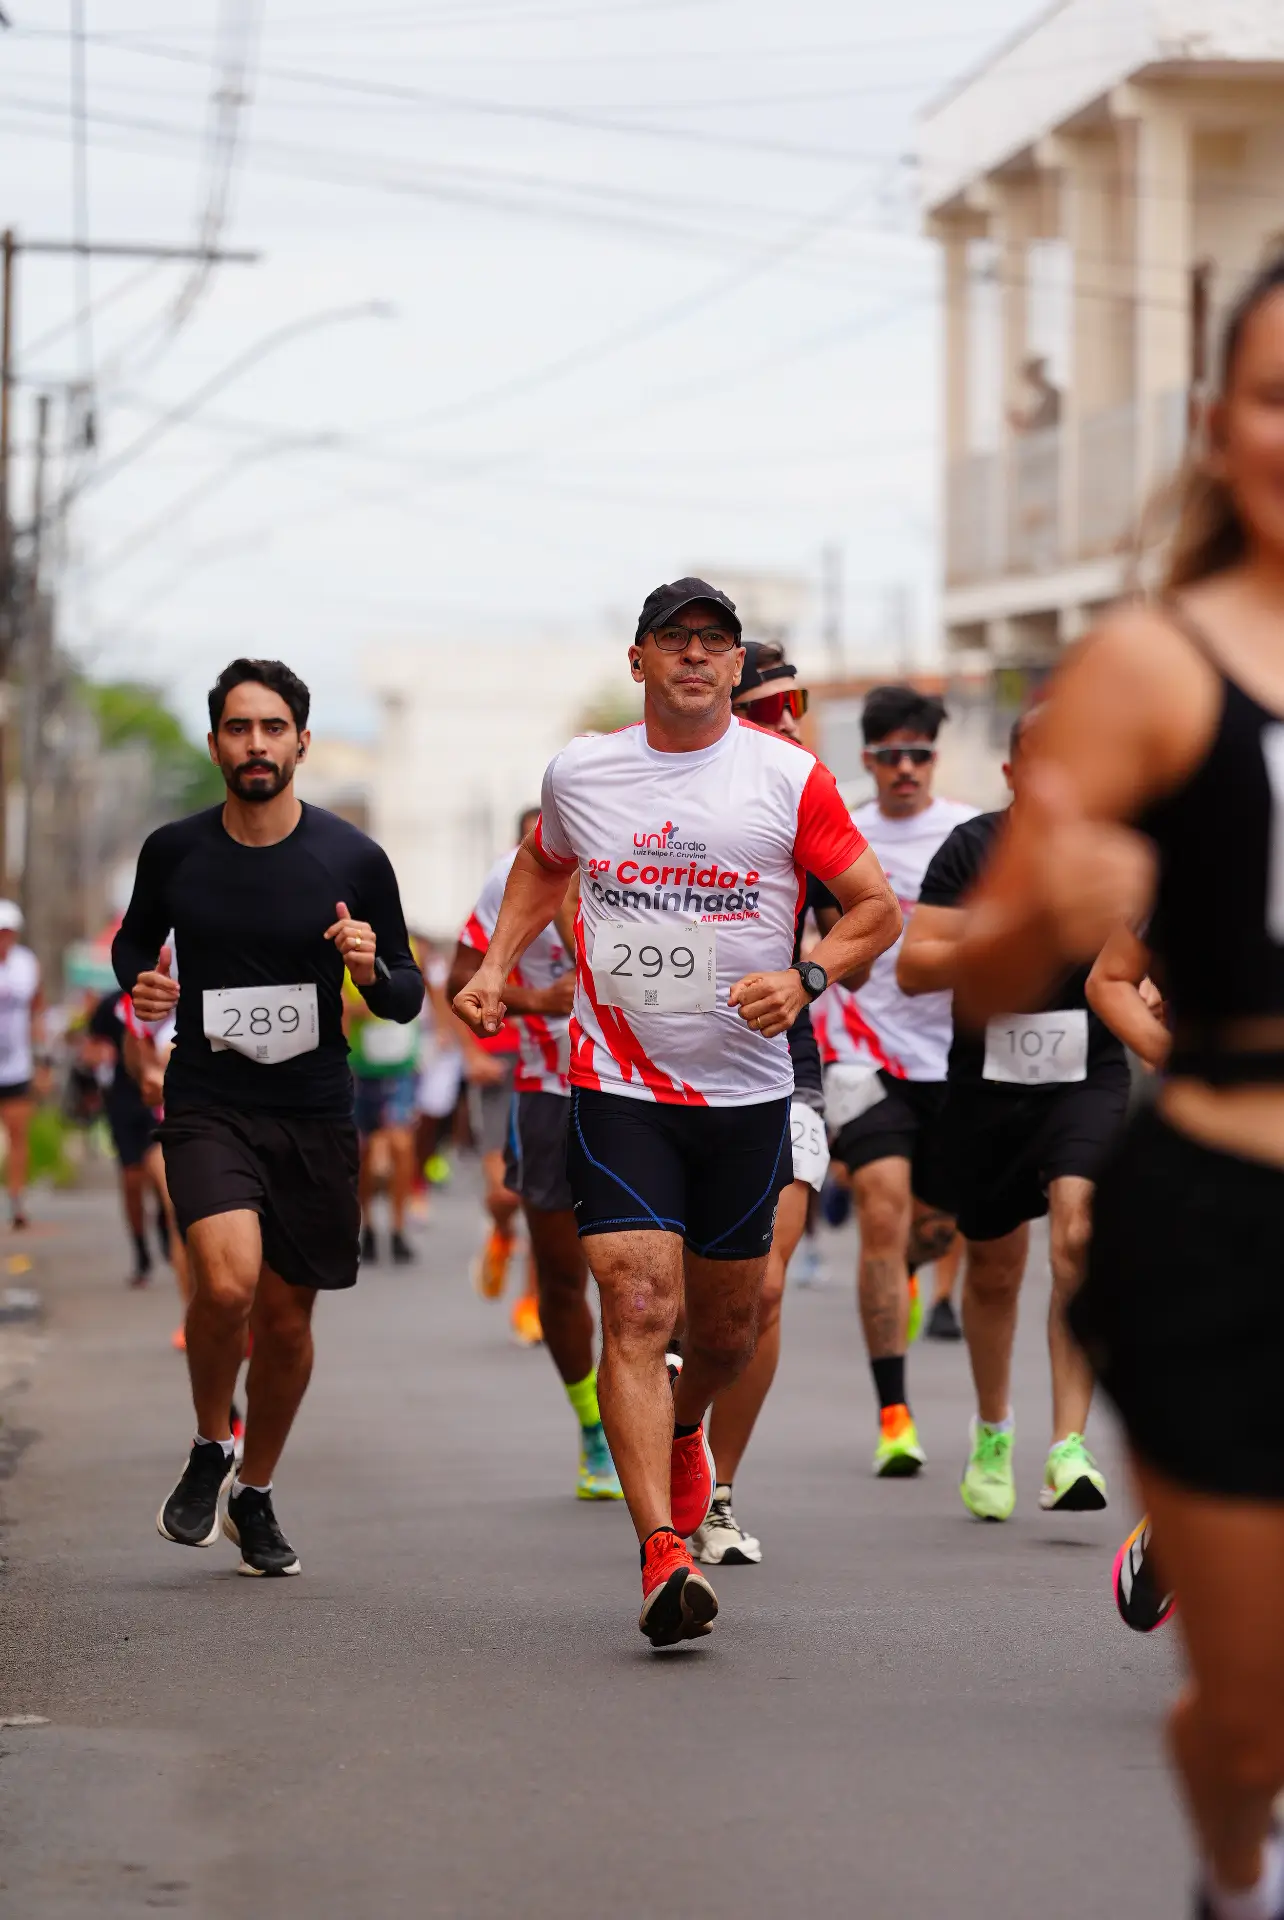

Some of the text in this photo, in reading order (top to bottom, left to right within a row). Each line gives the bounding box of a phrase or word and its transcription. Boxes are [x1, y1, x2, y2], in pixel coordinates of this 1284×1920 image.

[633, 849, 646, 857] Luiz
[648, 850, 668, 859] Felipe
[617, 860, 739, 888] Corrida
[745, 870, 760, 886] e
[591, 882, 760, 912] Caminhada
[610, 943, 695, 978] 299
[222, 1005, 300, 1037] 289
[1005, 1030, 1066, 1057] 107
